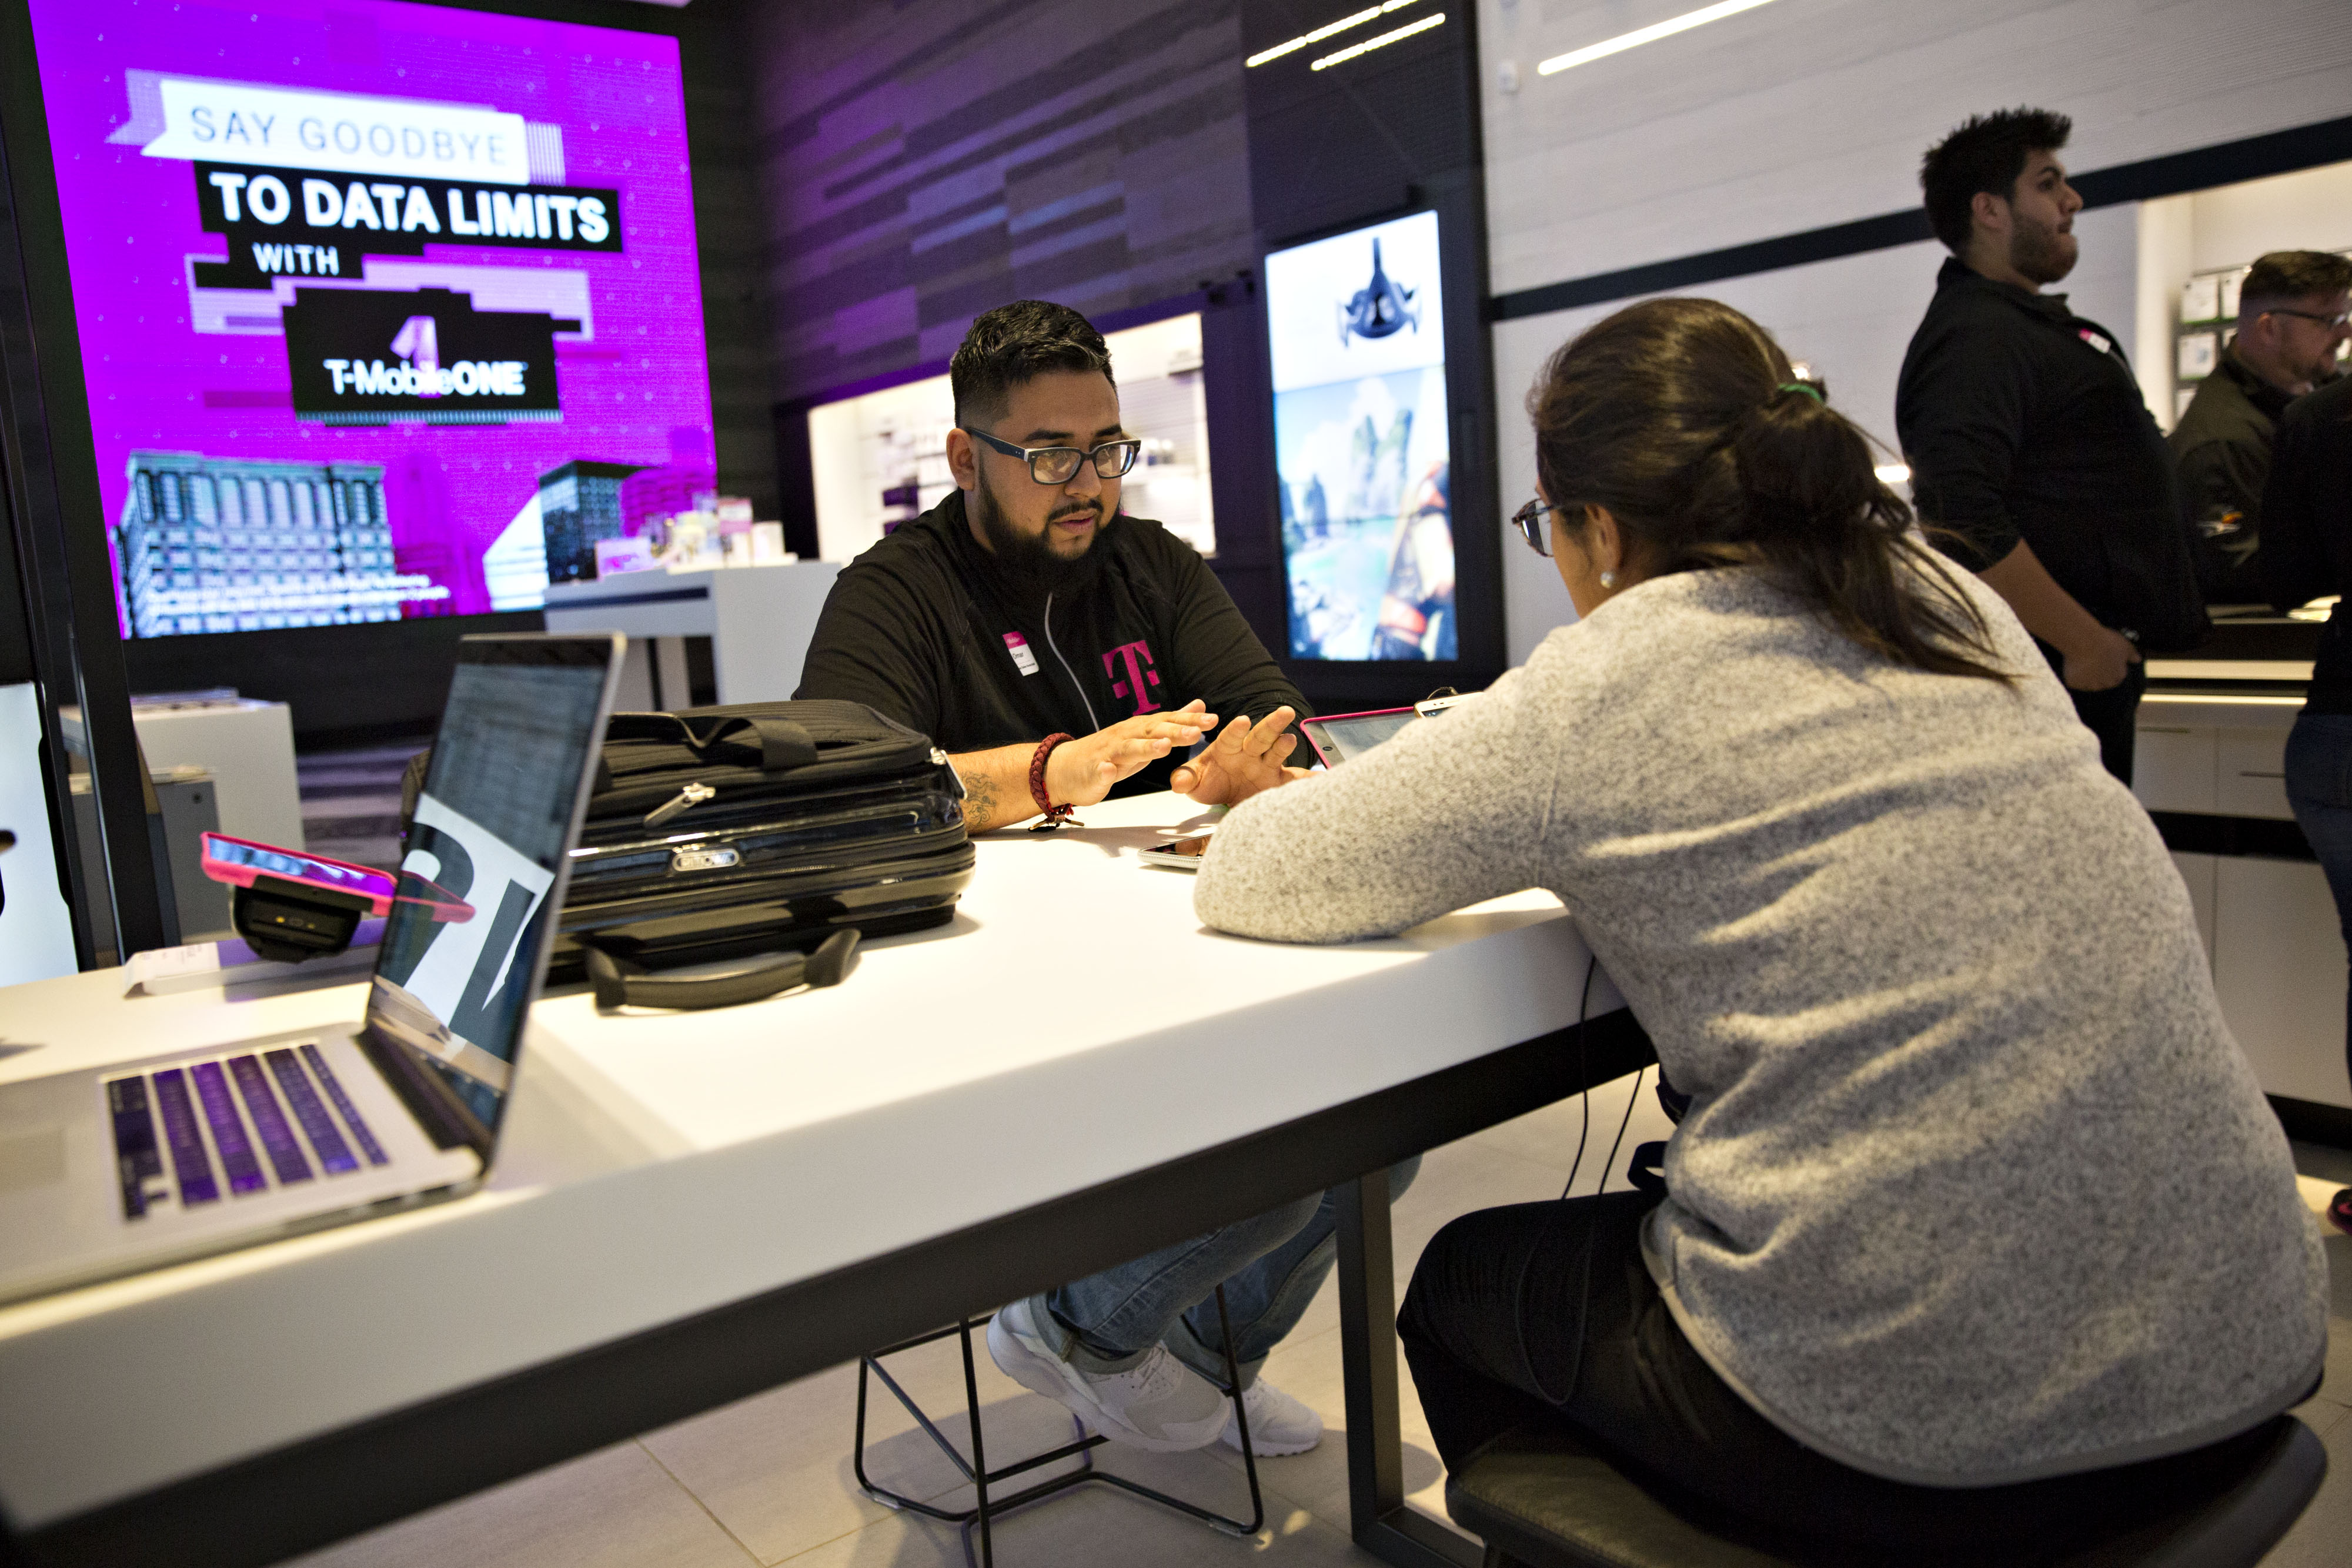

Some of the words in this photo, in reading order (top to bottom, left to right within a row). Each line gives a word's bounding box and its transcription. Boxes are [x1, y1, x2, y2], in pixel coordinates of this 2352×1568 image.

[191, 106, 275, 146] SAY
[299, 117, 508, 166] GOODBYE
[209, 172, 291, 225] TO
[301, 178, 441, 233] DATA
[447, 188, 610, 243] LIMITS
[252, 242, 340, 275] WITH
